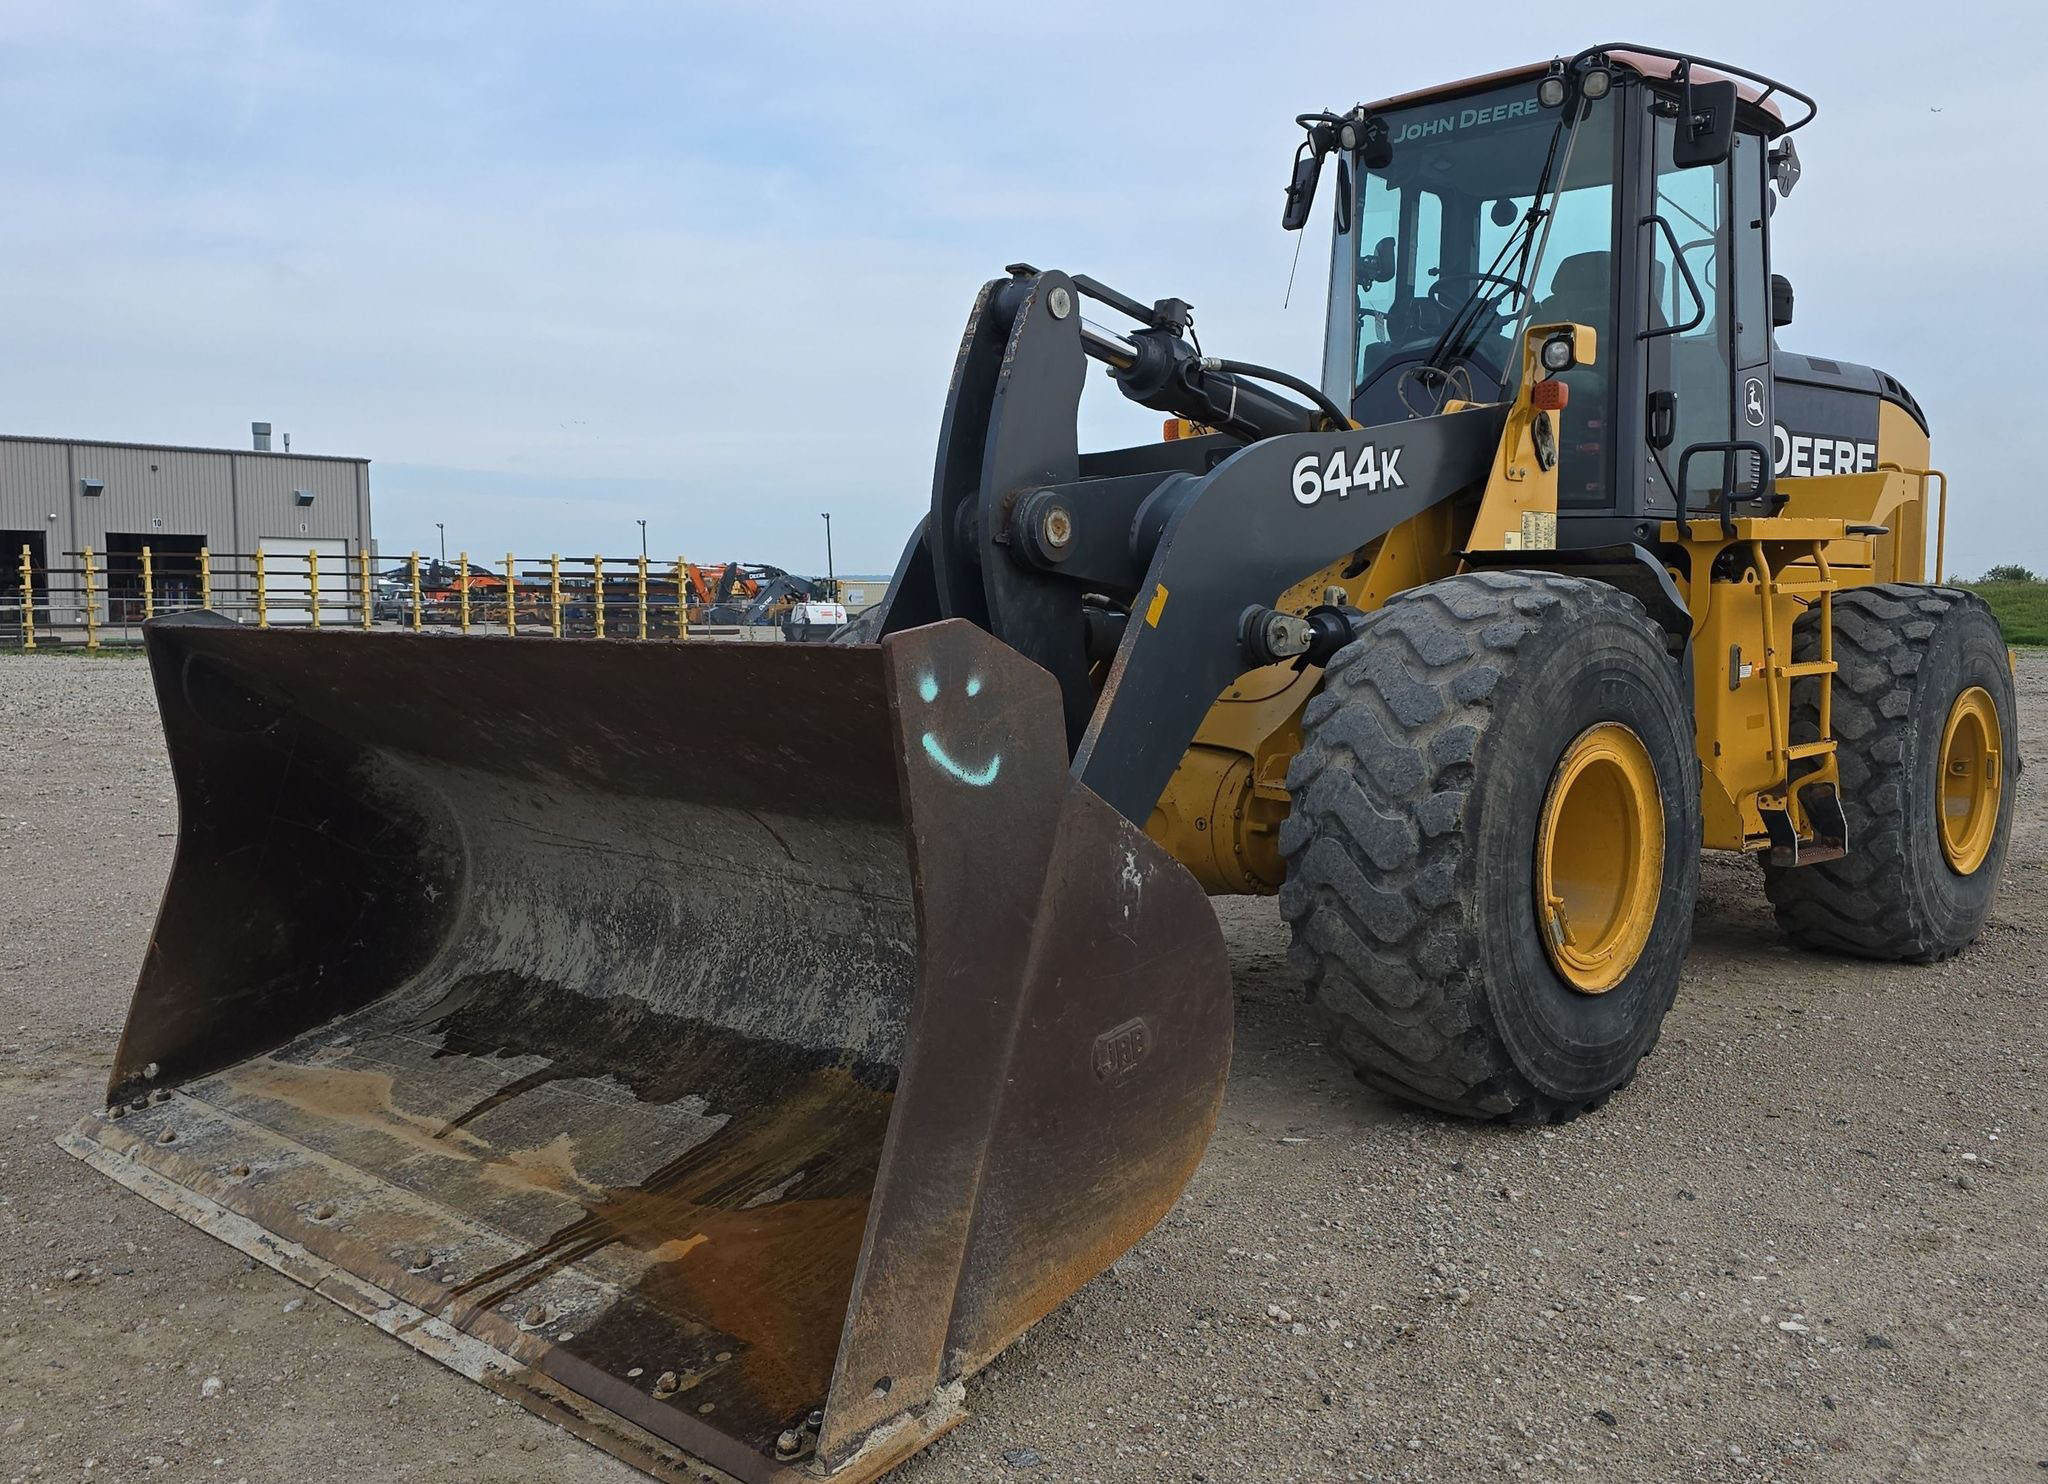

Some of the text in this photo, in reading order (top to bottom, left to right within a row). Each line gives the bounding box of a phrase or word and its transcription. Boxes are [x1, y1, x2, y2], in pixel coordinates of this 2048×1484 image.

[1393, 97, 1539, 144] JOHN DEERE
[1773, 424, 1876, 477] DEERE
[1292, 445, 1405, 505] 644K
[153, 519, 162, 527] 10
[301, 524, 306, 532] 9
[749, 572, 766, 580] DEERE
